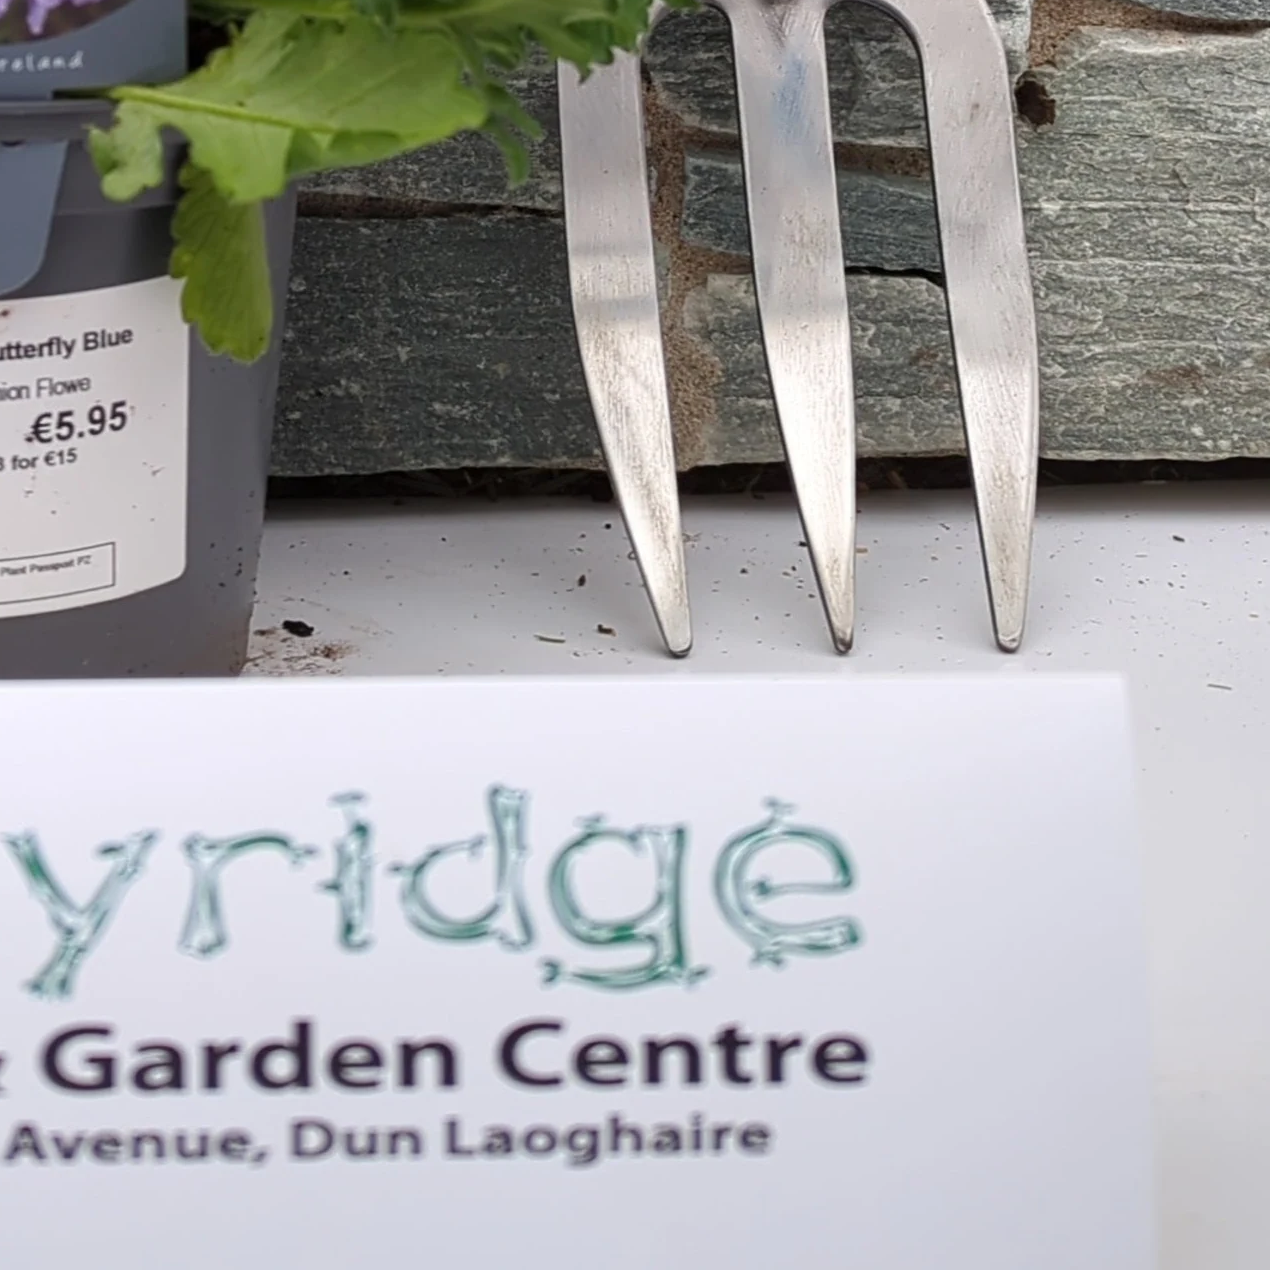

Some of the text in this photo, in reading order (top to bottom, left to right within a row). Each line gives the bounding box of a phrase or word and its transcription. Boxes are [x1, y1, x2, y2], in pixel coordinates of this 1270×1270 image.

[83, 328, 133, 352] Blue
[36, 376, 91, 398] Flowe
[31, 400, 127, 444] €5.95
[11, 454, 39, 470] for
[44, 447, 77, 466] €15
[41, 1021, 459, 1093] Garden
[497, 1017, 871, 1089] Centre
[4, 1121, 268, 1166] Avenue,
[290, 1117, 424, 1161] Dun
[445, 1112, 773, 1167] Laoghaire
